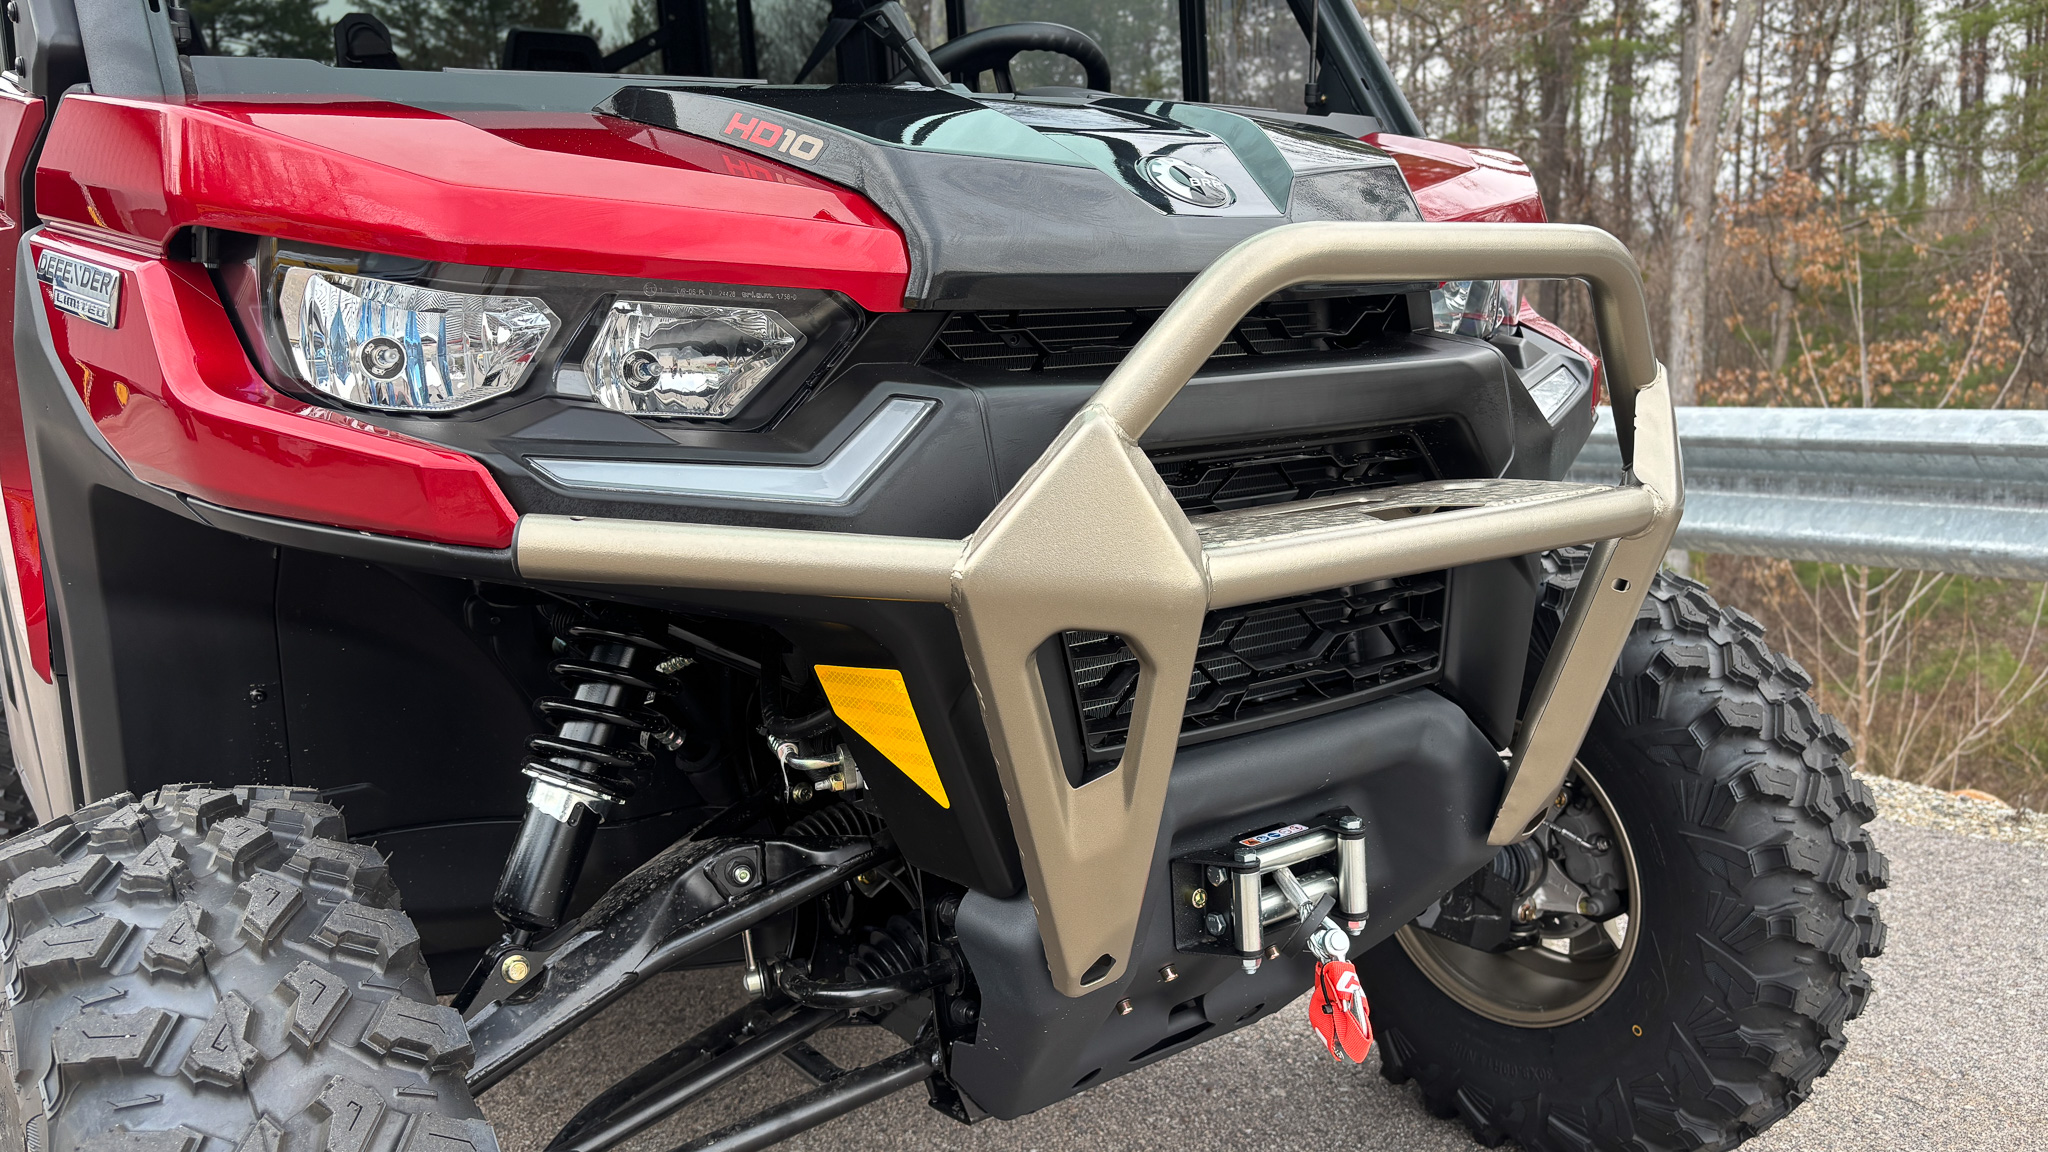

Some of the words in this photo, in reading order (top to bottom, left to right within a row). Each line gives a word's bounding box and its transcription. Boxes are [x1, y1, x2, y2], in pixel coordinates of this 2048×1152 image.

[723, 112, 824, 161] HD10
[37, 253, 113, 296] DEFENDER
[56, 292, 106, 318] LIMITED
